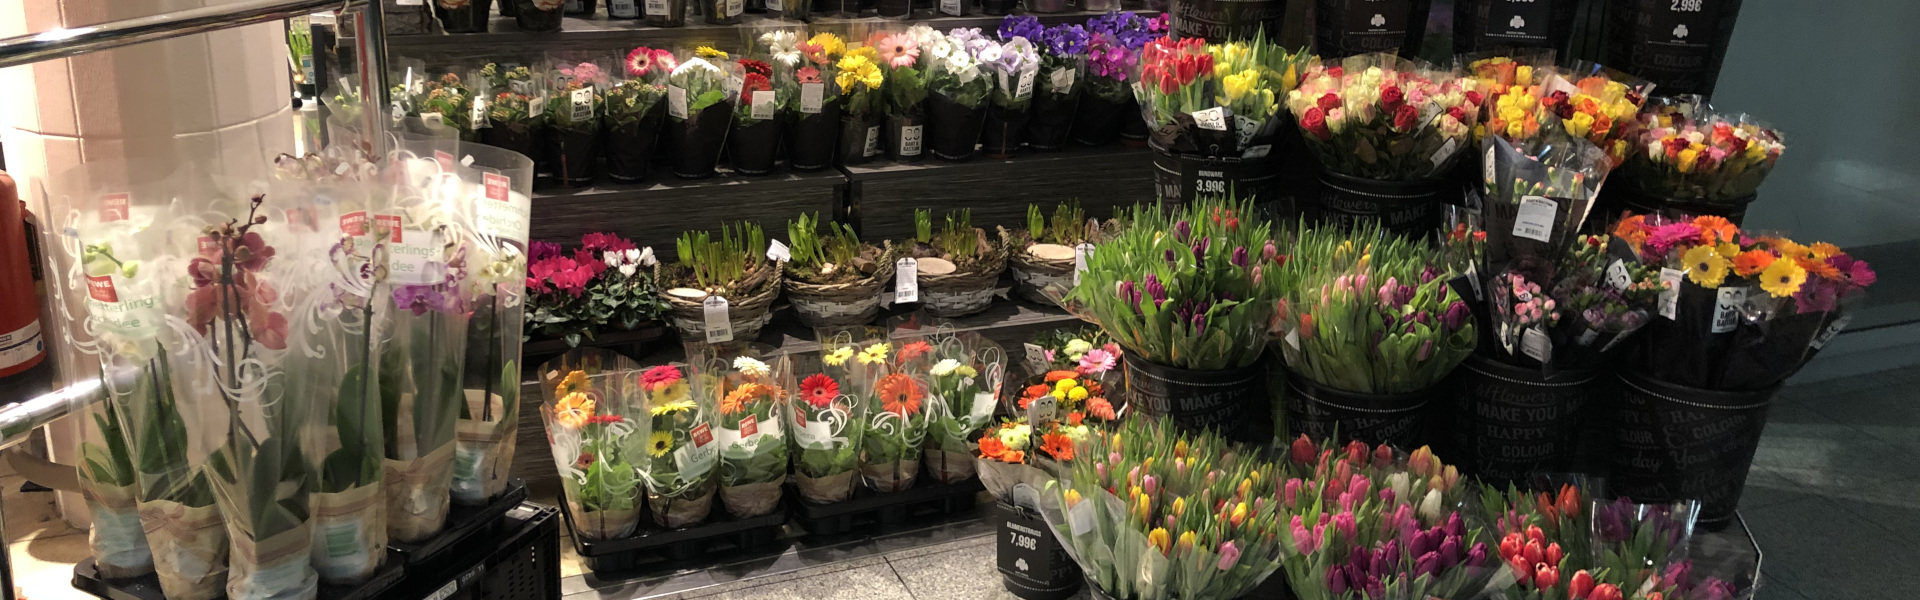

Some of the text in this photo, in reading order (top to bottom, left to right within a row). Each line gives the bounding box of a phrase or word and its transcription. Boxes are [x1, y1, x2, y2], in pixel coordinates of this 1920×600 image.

[1175, 16, 1233, 39] MAKE YOU
[1196, 179, 1225, 193] 3,99€
[1146, 396, 1172, 413] YOU
[1179, 391, 1223, 412] MAKE
[1477, 402, 1522, 423] MAKE
[1526, 404, 1557, 423] YOU
[692, 426, 709, 438] REWE
[1487, 425, 1547, 441] HAPPY
[1502, 442, 1555, 458] COLOUR
[1010, 531, 1037, 551] 7,99€
